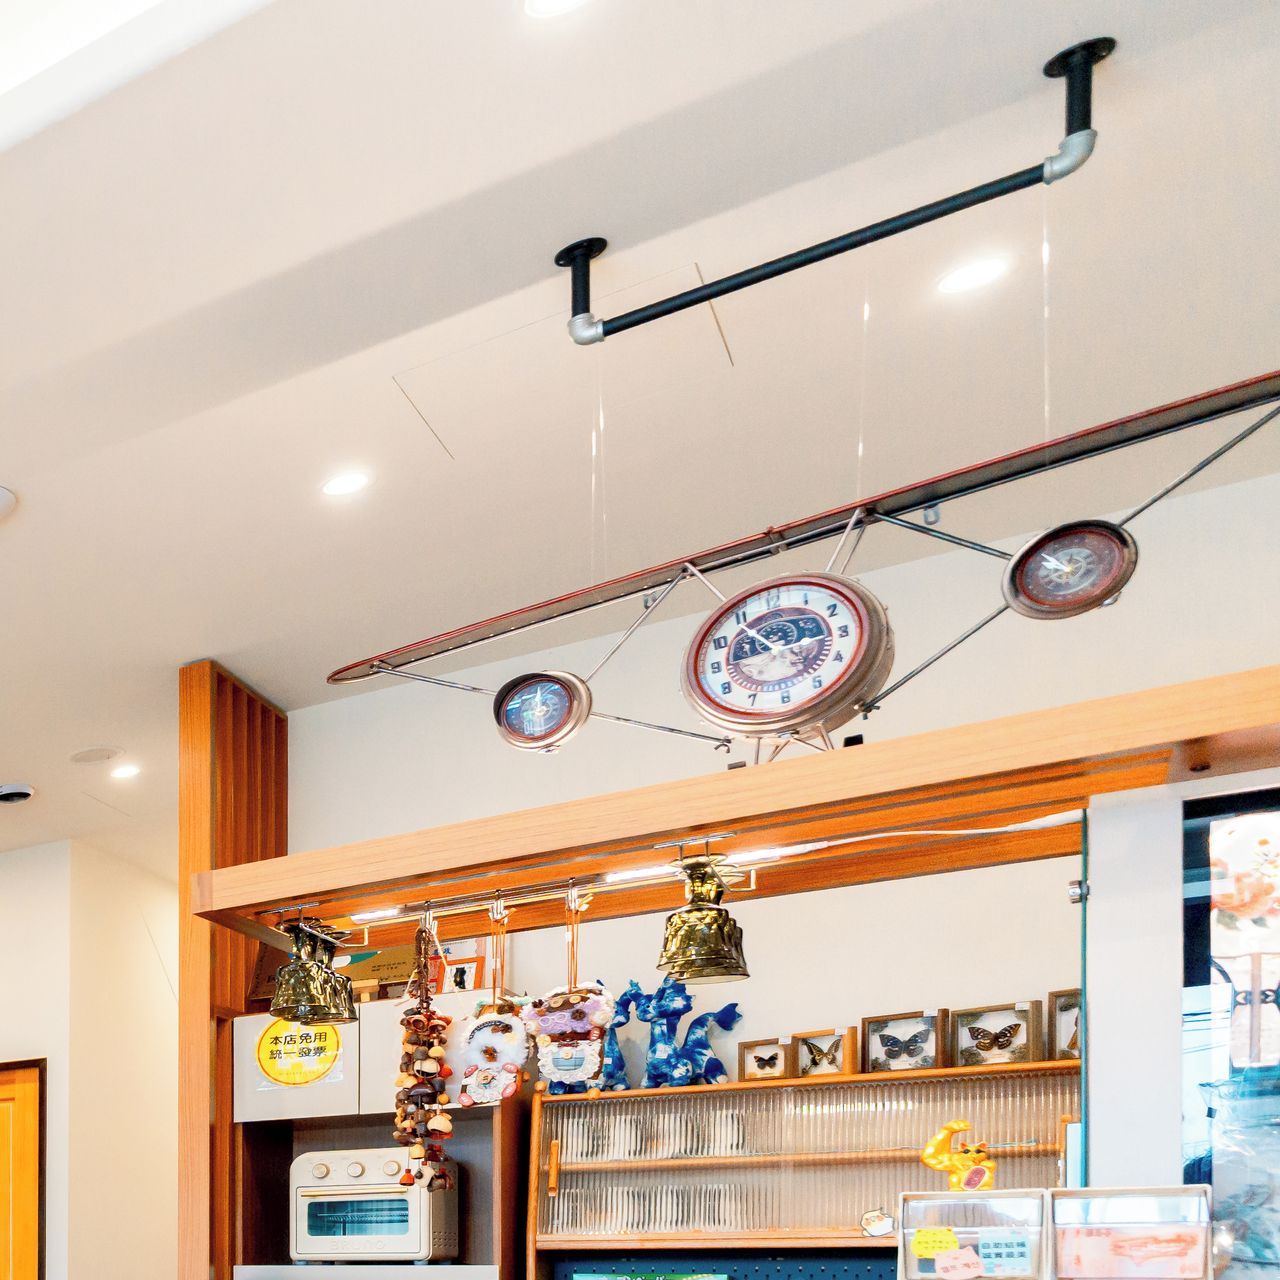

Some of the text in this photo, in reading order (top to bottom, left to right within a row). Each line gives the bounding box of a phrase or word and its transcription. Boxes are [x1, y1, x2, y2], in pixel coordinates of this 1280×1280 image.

[826, 603, 839, 617] 2
[735, 610, 747, 625] 11
[837, 624, 849, 638] 3
[712, 635, 728, 650] 10
[832, 650, 844, 663] 4
[710, 661, 722, 674] 9
[720, 681, 732, 695] 8
[812, 675, 823, 689] 5
[748, 692, 757, 707] 7
[781, 691, 790, 704] 6
[269, 1032, 327, 1046] 本店免用
[269, 1046, 327, 1060] 統一發票
